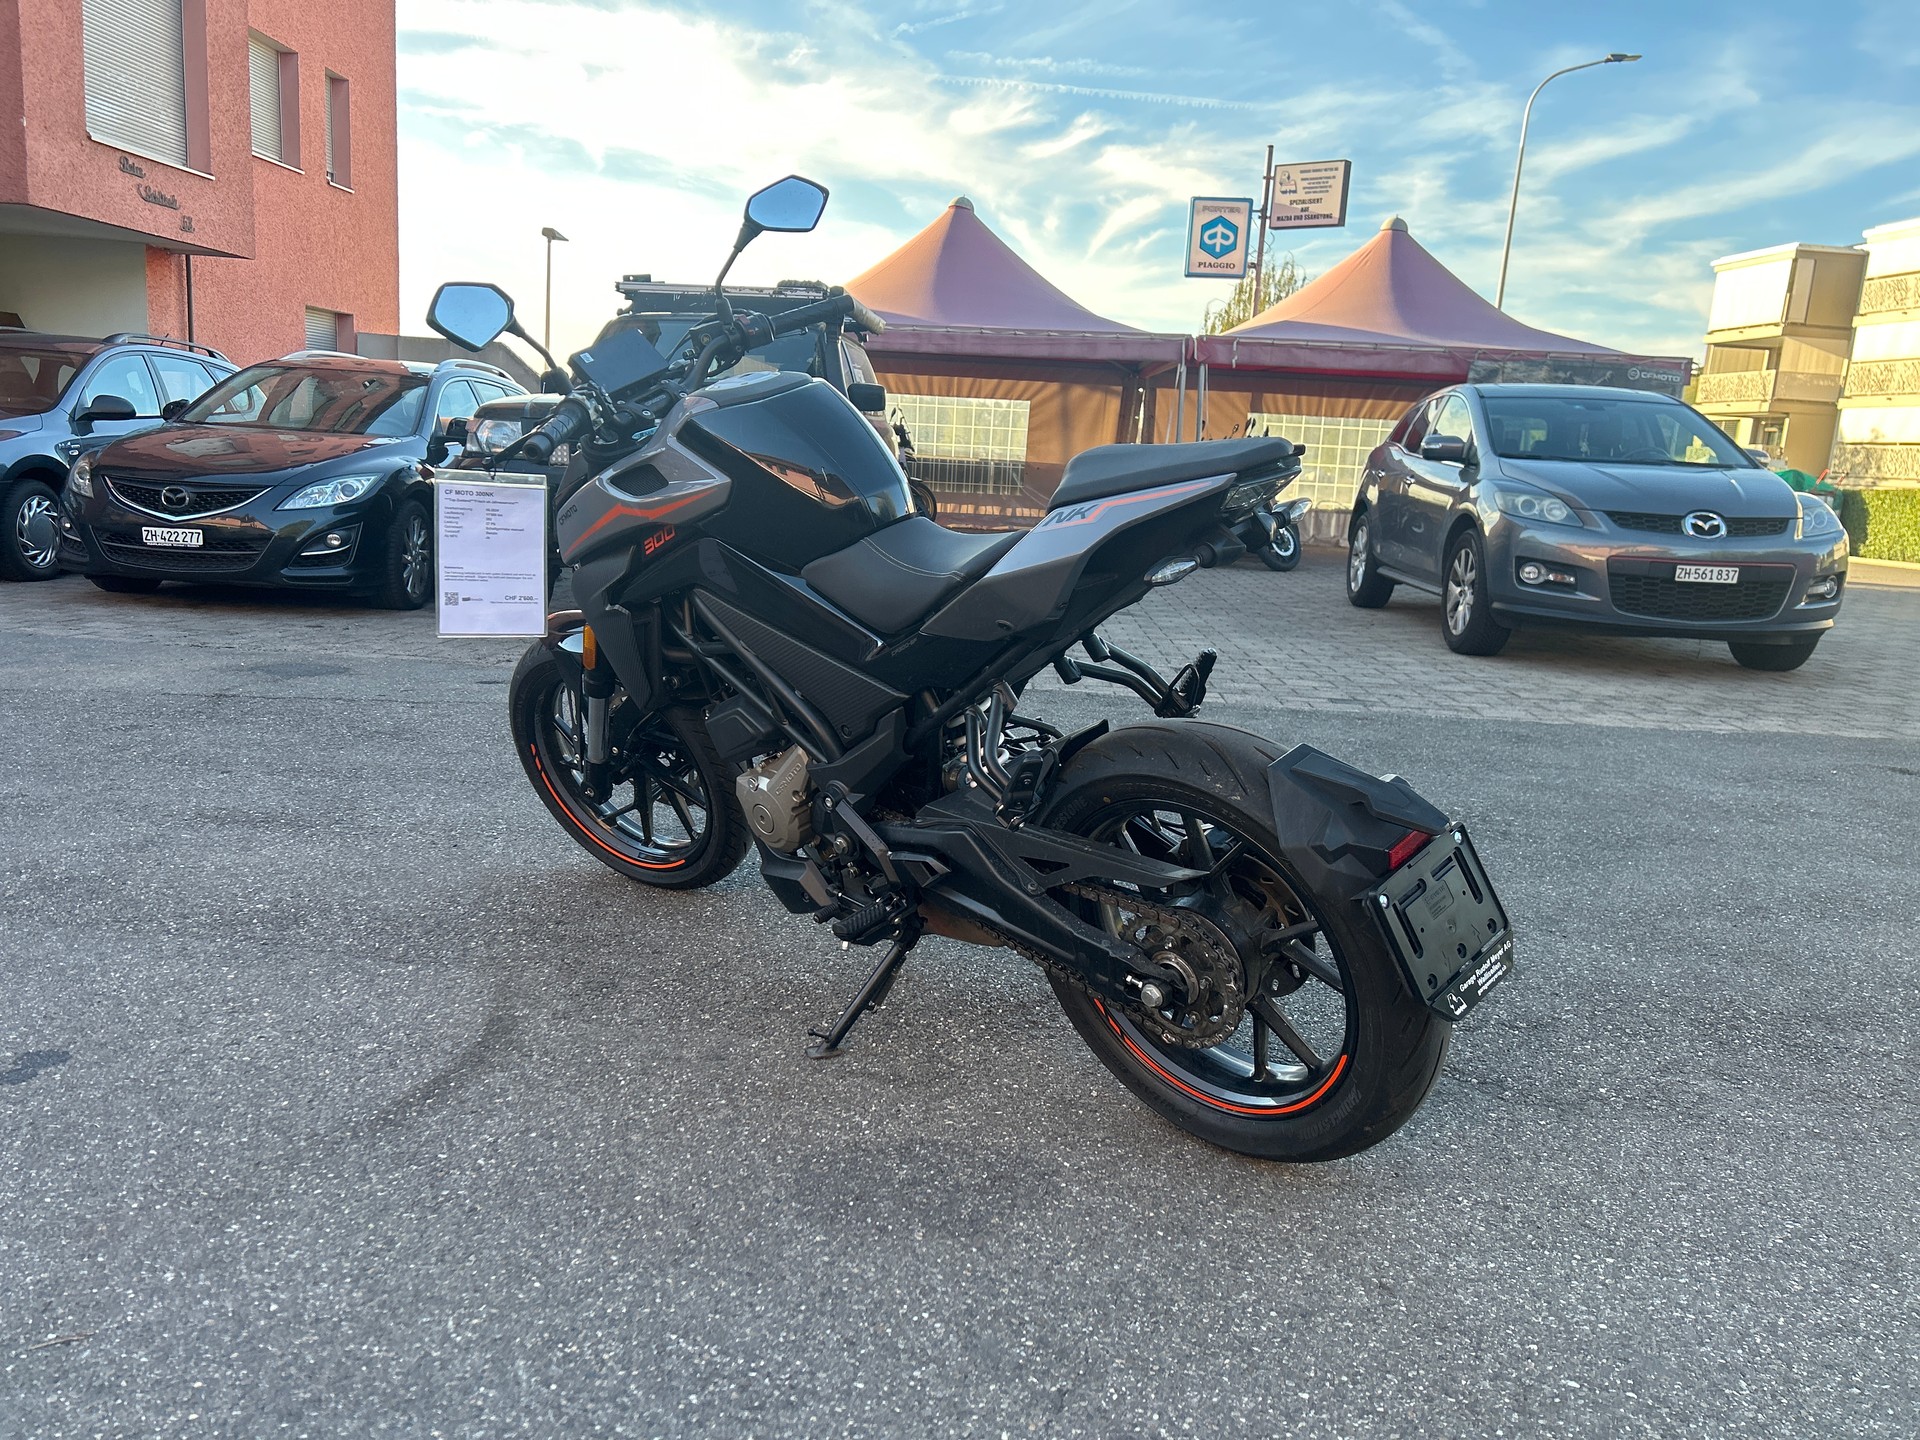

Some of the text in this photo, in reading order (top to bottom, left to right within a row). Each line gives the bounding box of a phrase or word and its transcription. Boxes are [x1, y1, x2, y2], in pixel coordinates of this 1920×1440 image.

[1289, 197, 1323, 206] SPEZIALISIERT
[1197, 261, 1236, 270] PIAGGIO
[1641, 372, 1681, 382] CFMOTO
[559, 504, 578, 526] CFMOTO
[1041, 503, 1099, 528] NK
[643, 524, 676, 556] 300
[1490, 947, 1504, 963] Meyer
[1503, 940, 1512, 951] AG
